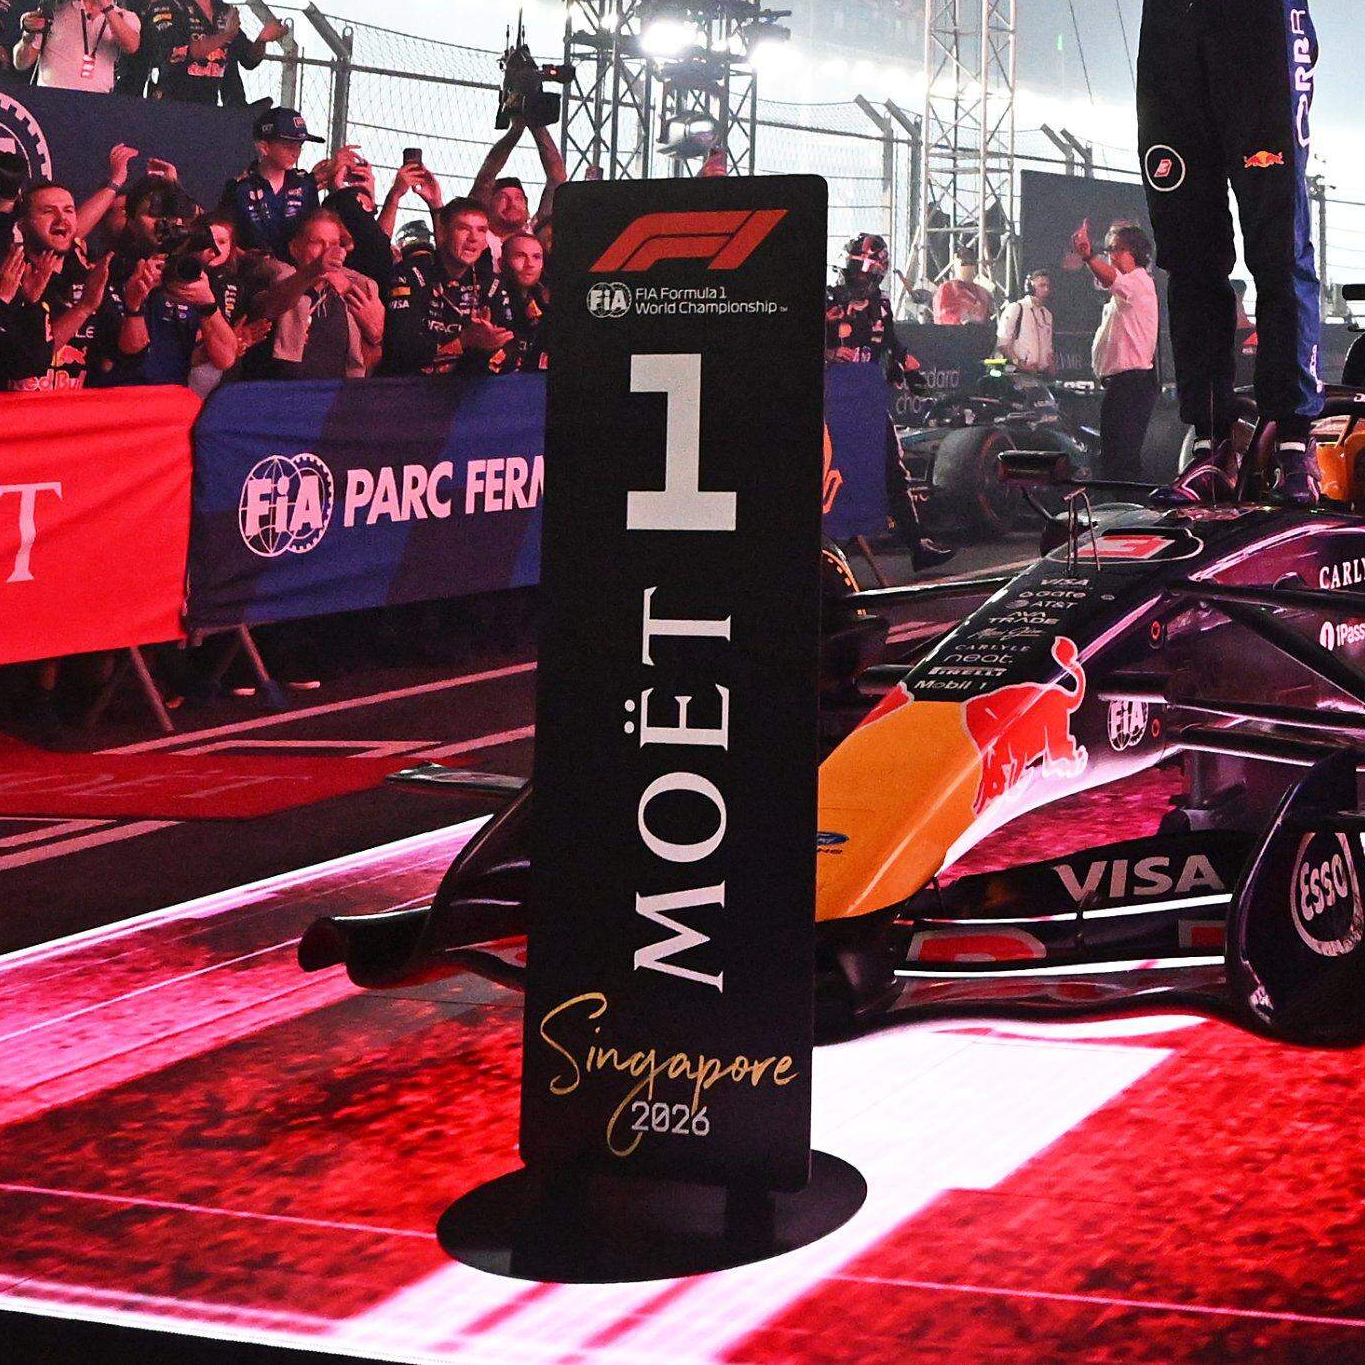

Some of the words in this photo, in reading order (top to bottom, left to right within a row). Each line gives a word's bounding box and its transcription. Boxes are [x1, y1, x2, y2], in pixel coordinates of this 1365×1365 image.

[635, 288, 658, 300] FIA
[661, 287, 717, 300] Formula
[720, 287, 727, 299] 1
[636, 301, 676, 315] World
[679, 300, 777, 314] Championship
[626, 353, 737, 531] 1
[343, 461, 453, 528] PARC
[1040, 578, 1089, 586] VISA
[1030, 601, 1079, 609] AT&T
[989, 617, 1060, 625] TRADE
[914, 680, 970, 689] Mobil
[623, 586, 732, 993] MOËT
[1052, 854, 1226, 902] VISA
[539, 991, 799, 1157] Singapore
[630, 1101, 711, 1137] 2026
